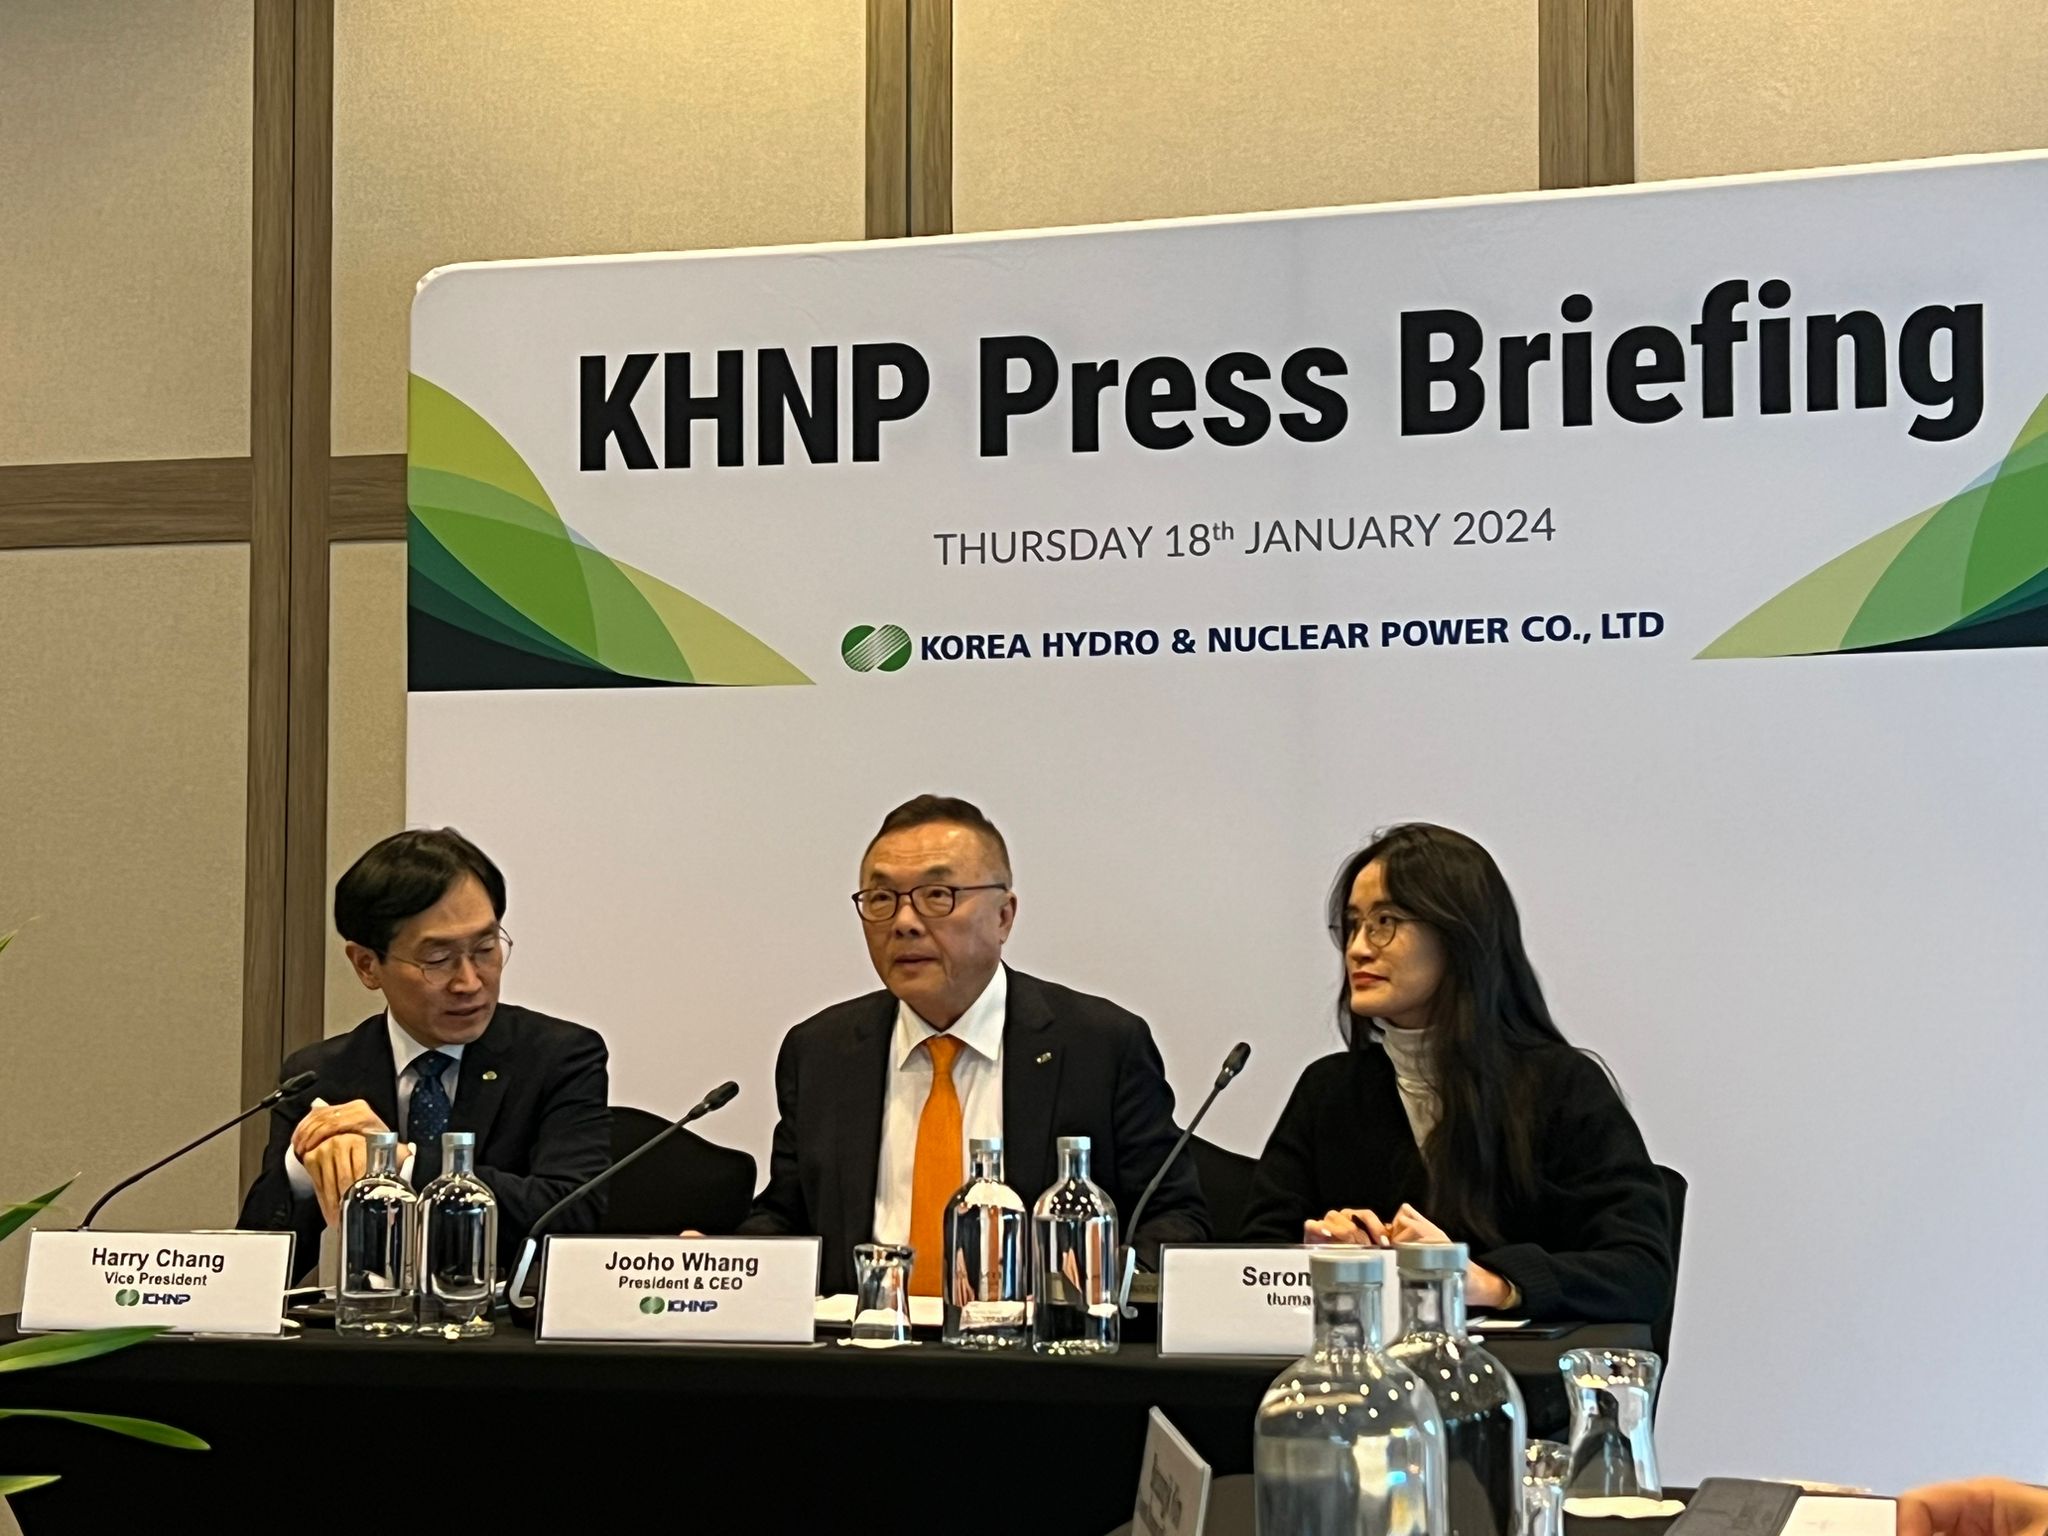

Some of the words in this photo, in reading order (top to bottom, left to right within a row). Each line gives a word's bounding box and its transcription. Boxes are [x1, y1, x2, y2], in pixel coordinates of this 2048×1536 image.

[579, 343, 929, 471] KHNP
[979, 335, 1348, 457] Press
[1400, 279, 1984, 442] Briefing
[933, 525, 1153, 566] THURSDAY
[1166, 520, 1234, 558] 18th
[1244, 513, 1441, 554] JANUARY
[1453, 507, 1556, 546] 2024
[921, 633, 1032, 661] KOREA
[1042, 629, 1160, 658] HYDRO
[1171, 628, 1196, 654] &
[1208, 622, 1370, 653] NUCLEAR
[1381, 617, 1510, 648] POWER
[1521, 614, 1592, 645] CO.,
[1601, 611, 1665, 640] LTD
[92, 1248, 149, 1271] Harry
[156, 1249, 224, 1273] Chang
[605, 1252, 674, 1271] Jooho
[682, 1253, 759, 1276] Whang
[104, 1272, 134, 1285] Vice
[139, 1272, 207, 1286] President
[619, 1276, 689, 1290] President
[693, 1277, 704, 1290] &
[709, 1277, 743, 1290] CEO
